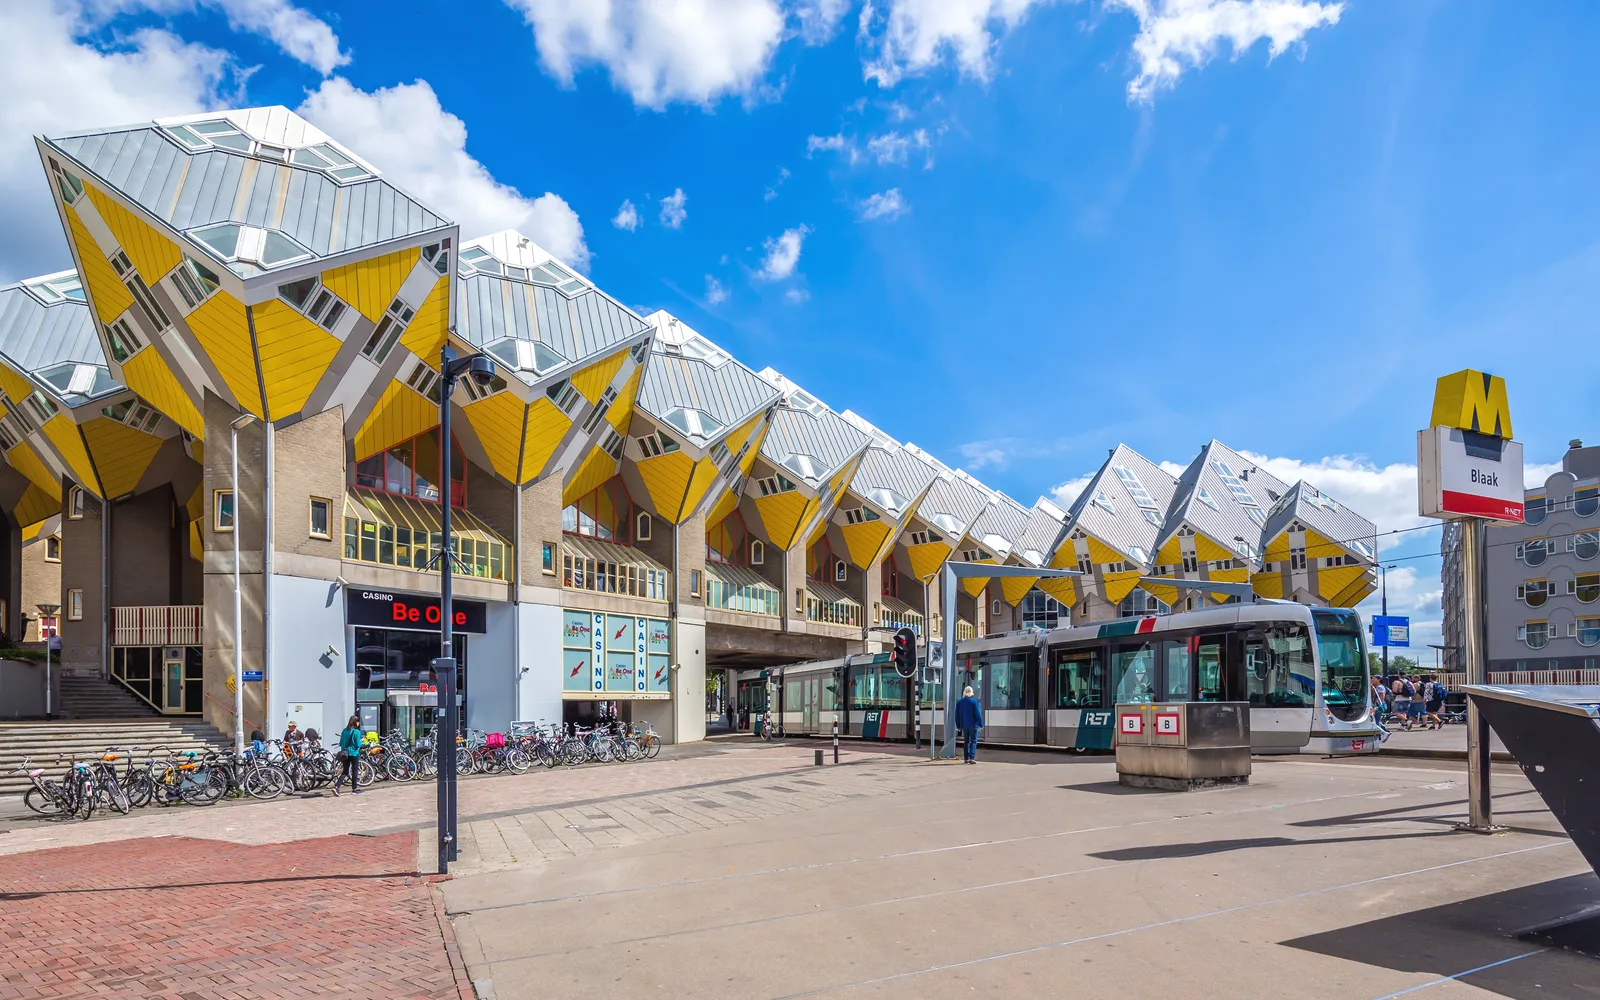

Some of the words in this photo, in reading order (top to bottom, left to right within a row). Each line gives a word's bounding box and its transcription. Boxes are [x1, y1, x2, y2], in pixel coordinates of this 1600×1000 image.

[1471, 469, 1499, 487] Blaak
[362, 591, 393, 602] CASINO
[392, 602, 421, 622] Be
[425, 605, 467, 625] Oe
[419, 683, 437, 693] Be
[866, 712, 879, 722] RET
[1084, 712, 1112, 726] RET
[1128, 719, 1135, 729] B
[1164, 719, 1170, 730] B
[1351, 739, 1366, 751] RET
